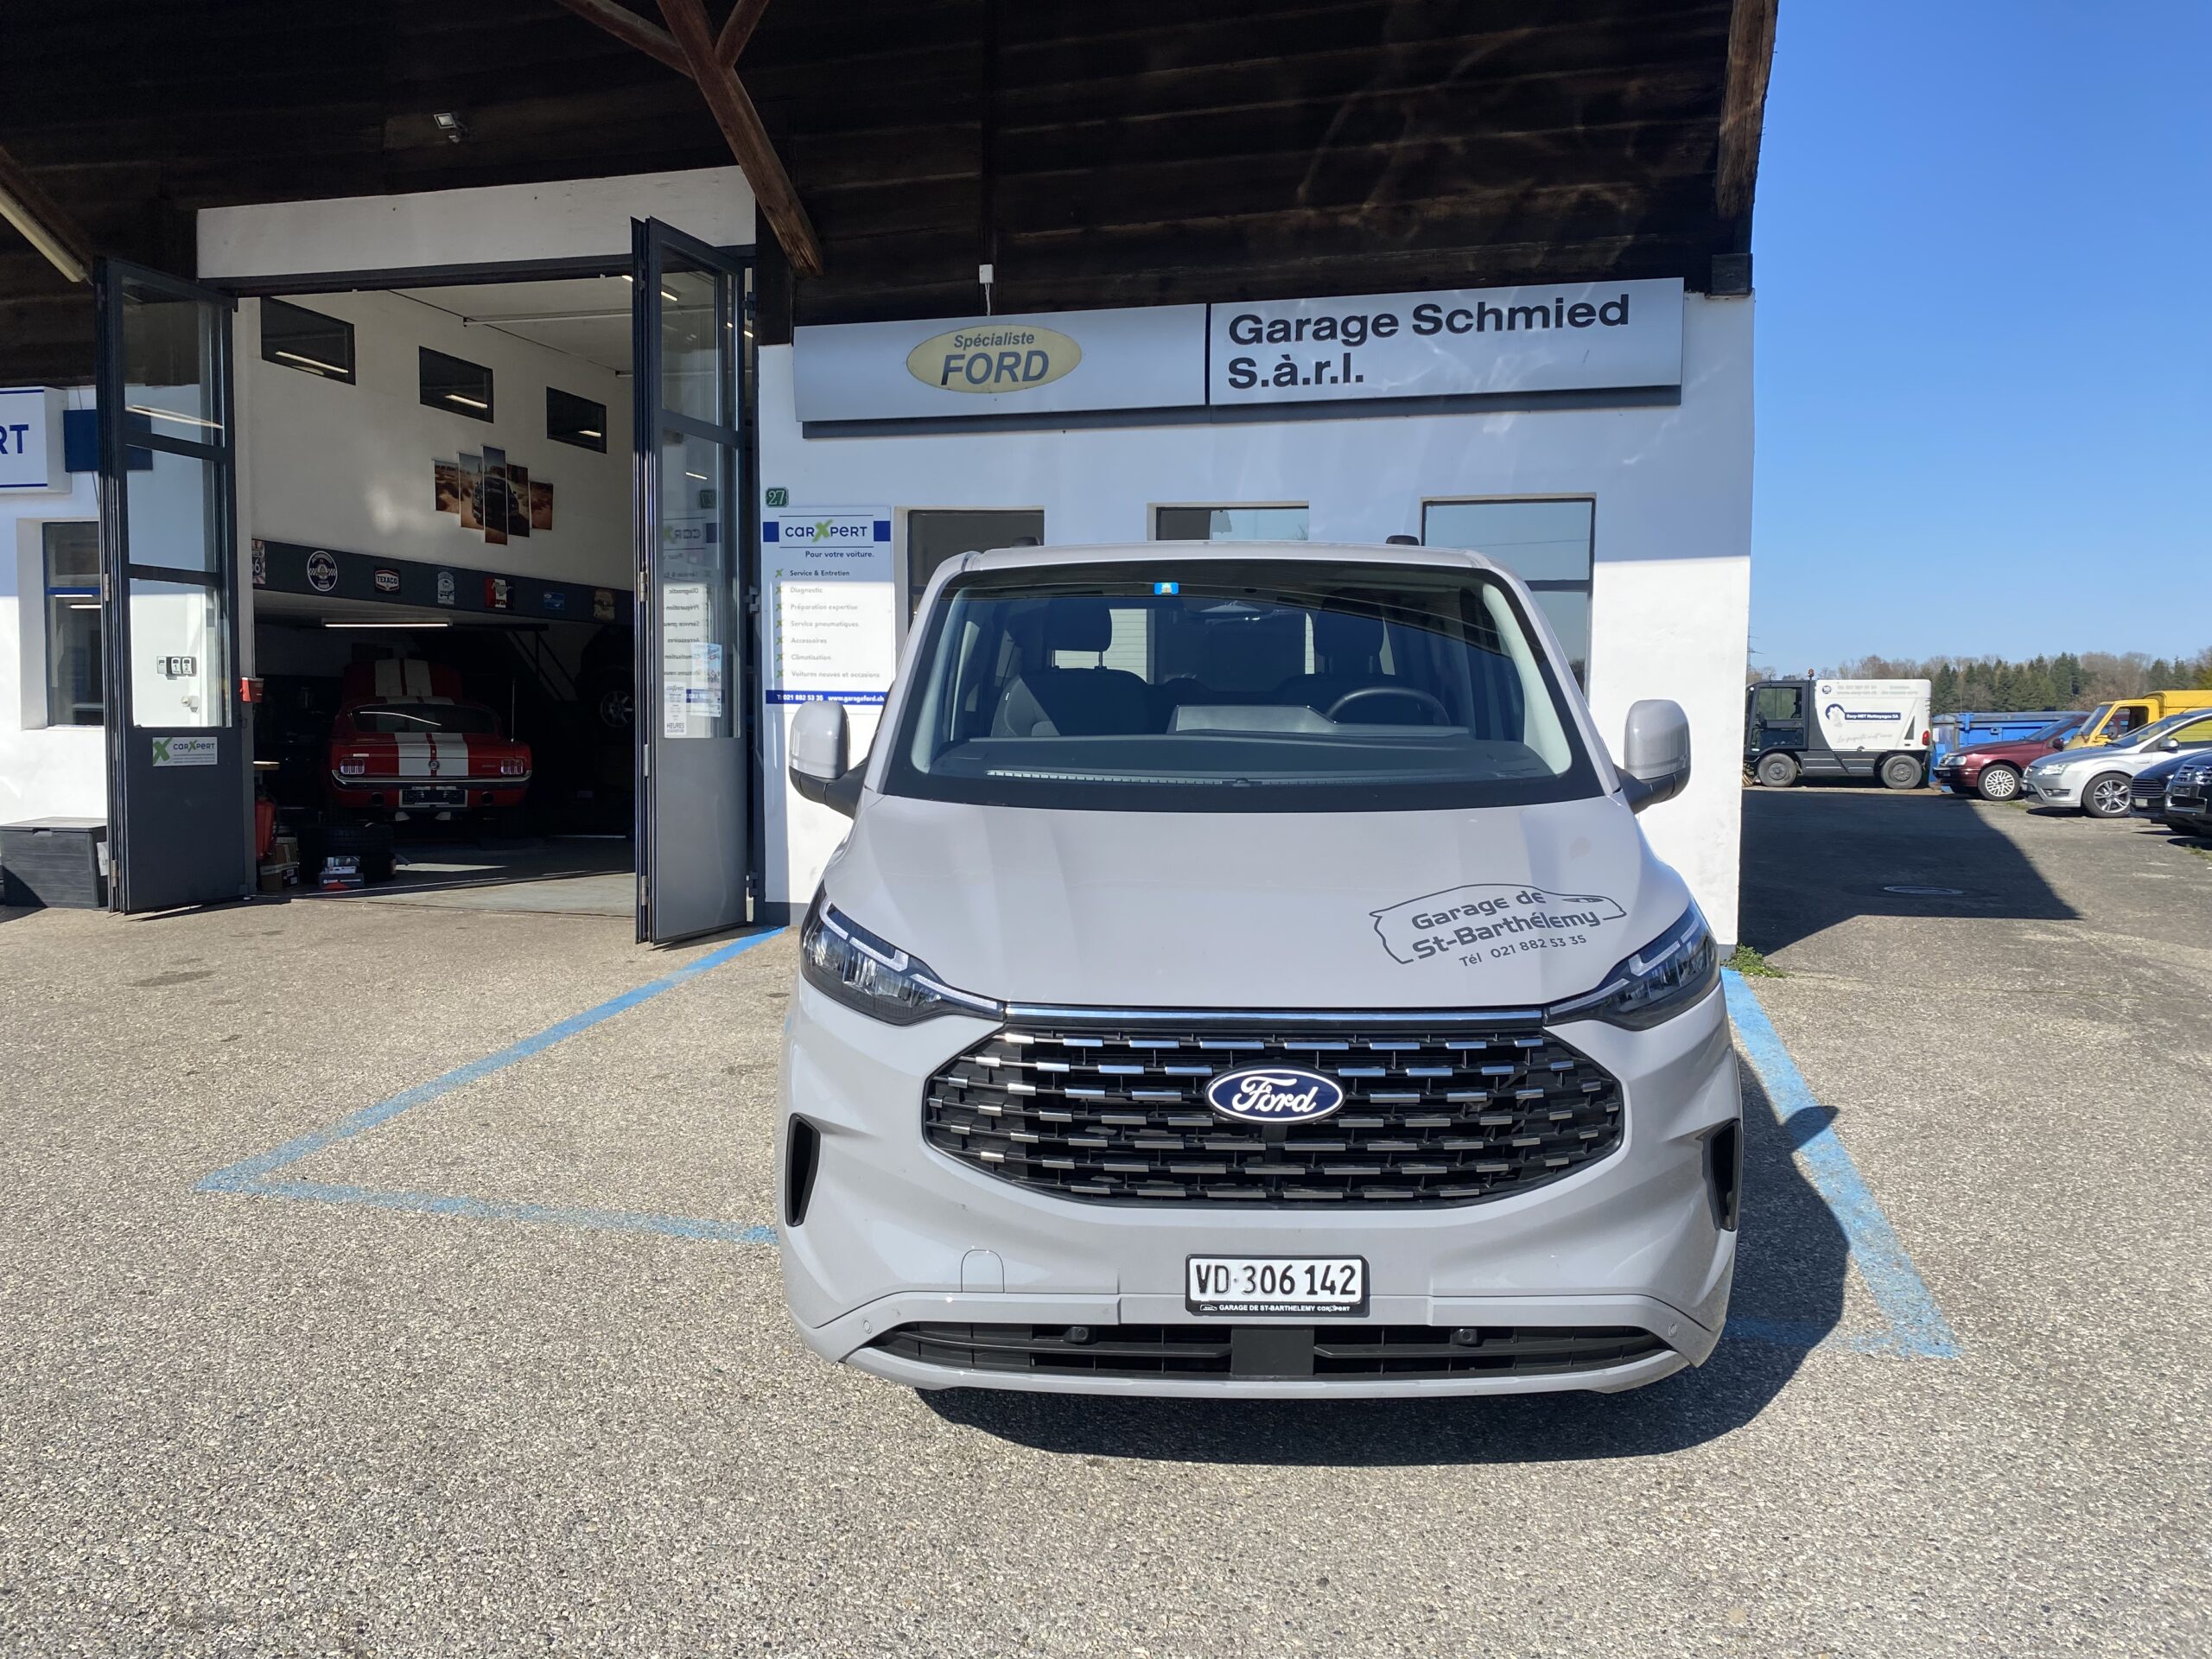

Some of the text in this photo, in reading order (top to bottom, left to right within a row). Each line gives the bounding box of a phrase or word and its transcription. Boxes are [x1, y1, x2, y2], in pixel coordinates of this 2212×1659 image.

[1228, 293, 1630, 346] Garage Schmied
[953, 332, 1035, 350] Spécialiste
[940, 350, 1050, 386] FORD
[1227, 353, 1364, 389] S.à.r.l.
[768, 490, 785, 505] 27
[377, 575, 397, 585] TEXACO
[1412, 890, 1547, 930] Garage de
[1412, 912, 1601, 959] St-Barthélemy
[1459, 935, 1586, 967] Tél 021 882 53 35
[1231, 1076, 1319, 1113] Ford
[1304, 1264, 1357, 1295] 142
